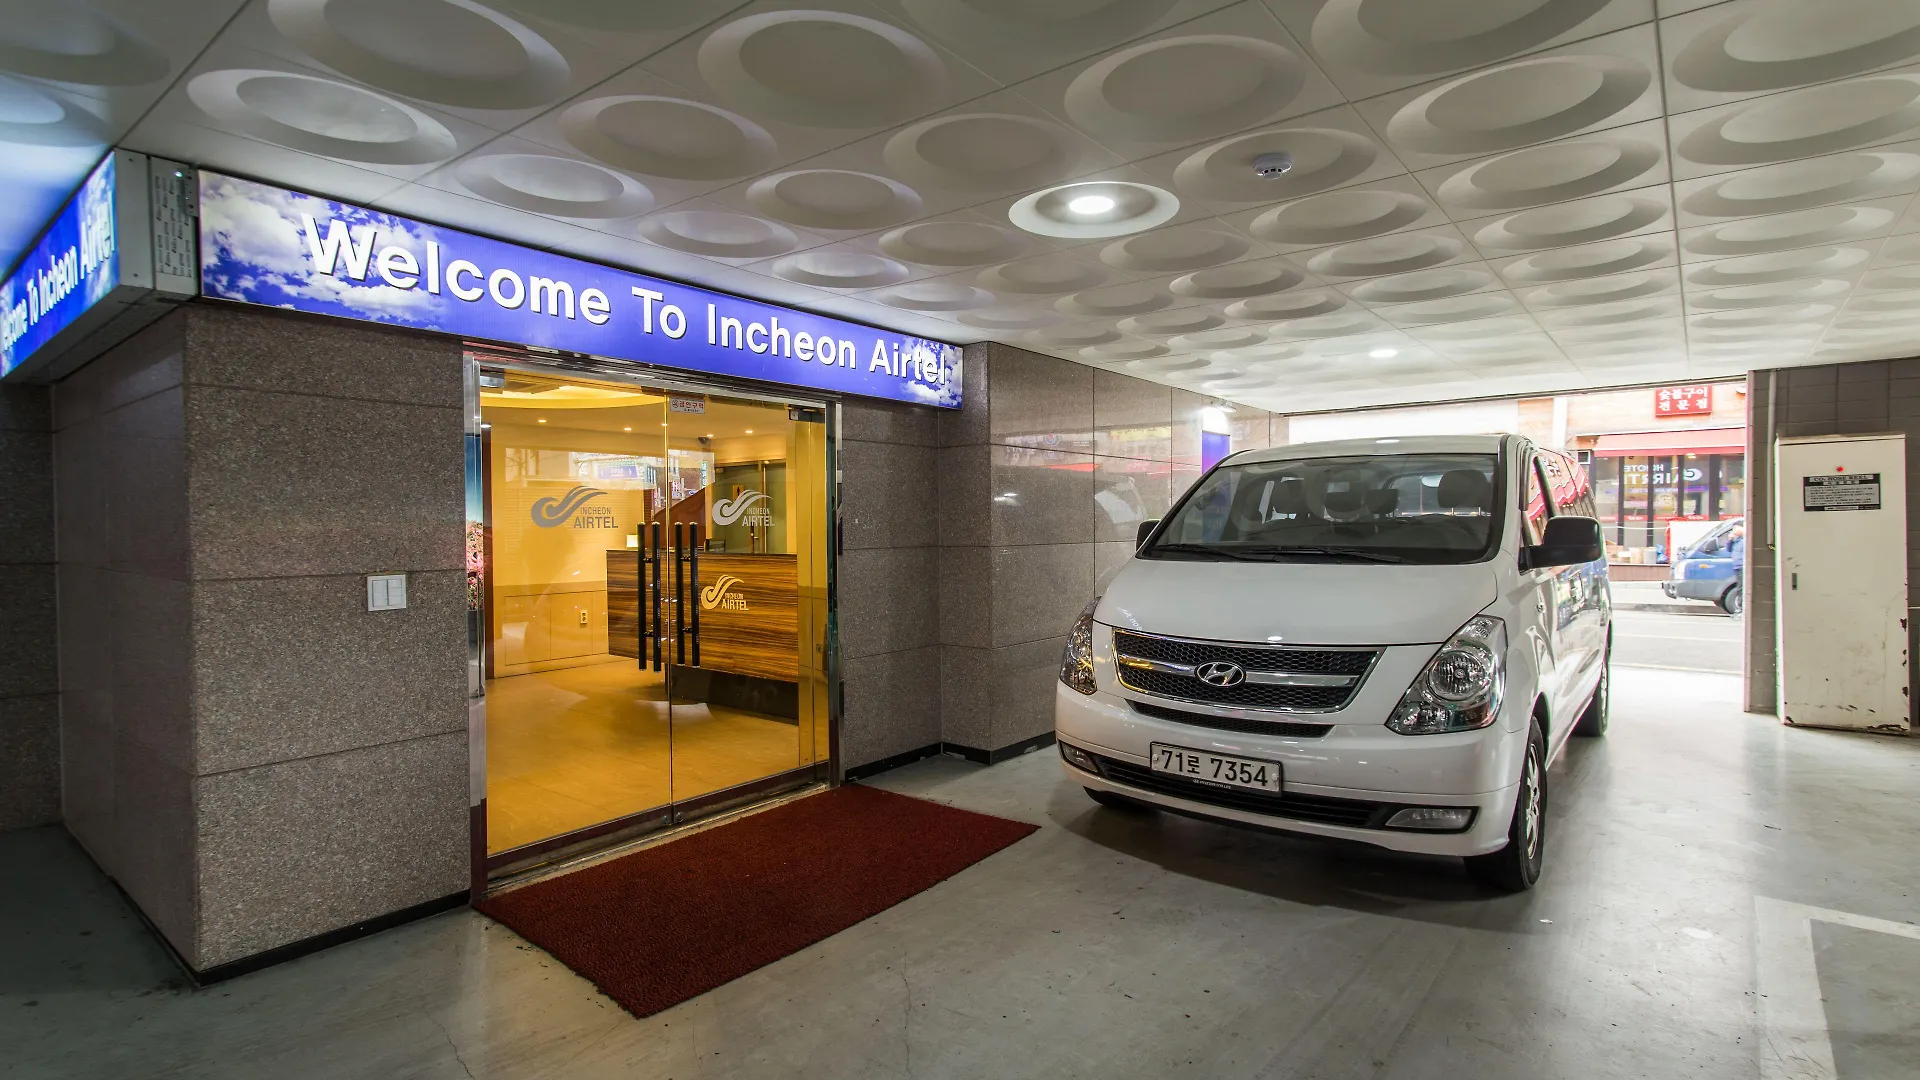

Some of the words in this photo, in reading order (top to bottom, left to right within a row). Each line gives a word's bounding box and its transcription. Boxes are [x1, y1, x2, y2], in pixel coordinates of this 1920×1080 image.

[27, 278, 39, 326] To
[38, 245, 78, 317] Incheon
[80, 190, 115, 280] Airtel
[301, 213, 611, 325] Welcome
[631, 286, 687, 339] To
[708, 303, 857, 369] Incheon
[869, 338, 946, 386] Airtel
[580, 506, 612, 515] INCHEON
[746, 507, 770, 515] INCHEON
[573, 516, 619, 529] AIRTEL
[741, 515, 776, 527] AIRTEL
[721, 598, 750, 611] AIRTEL
[1161, 749, 1200, 775] 71로
[1210, 757, 1268, 787] 7354
